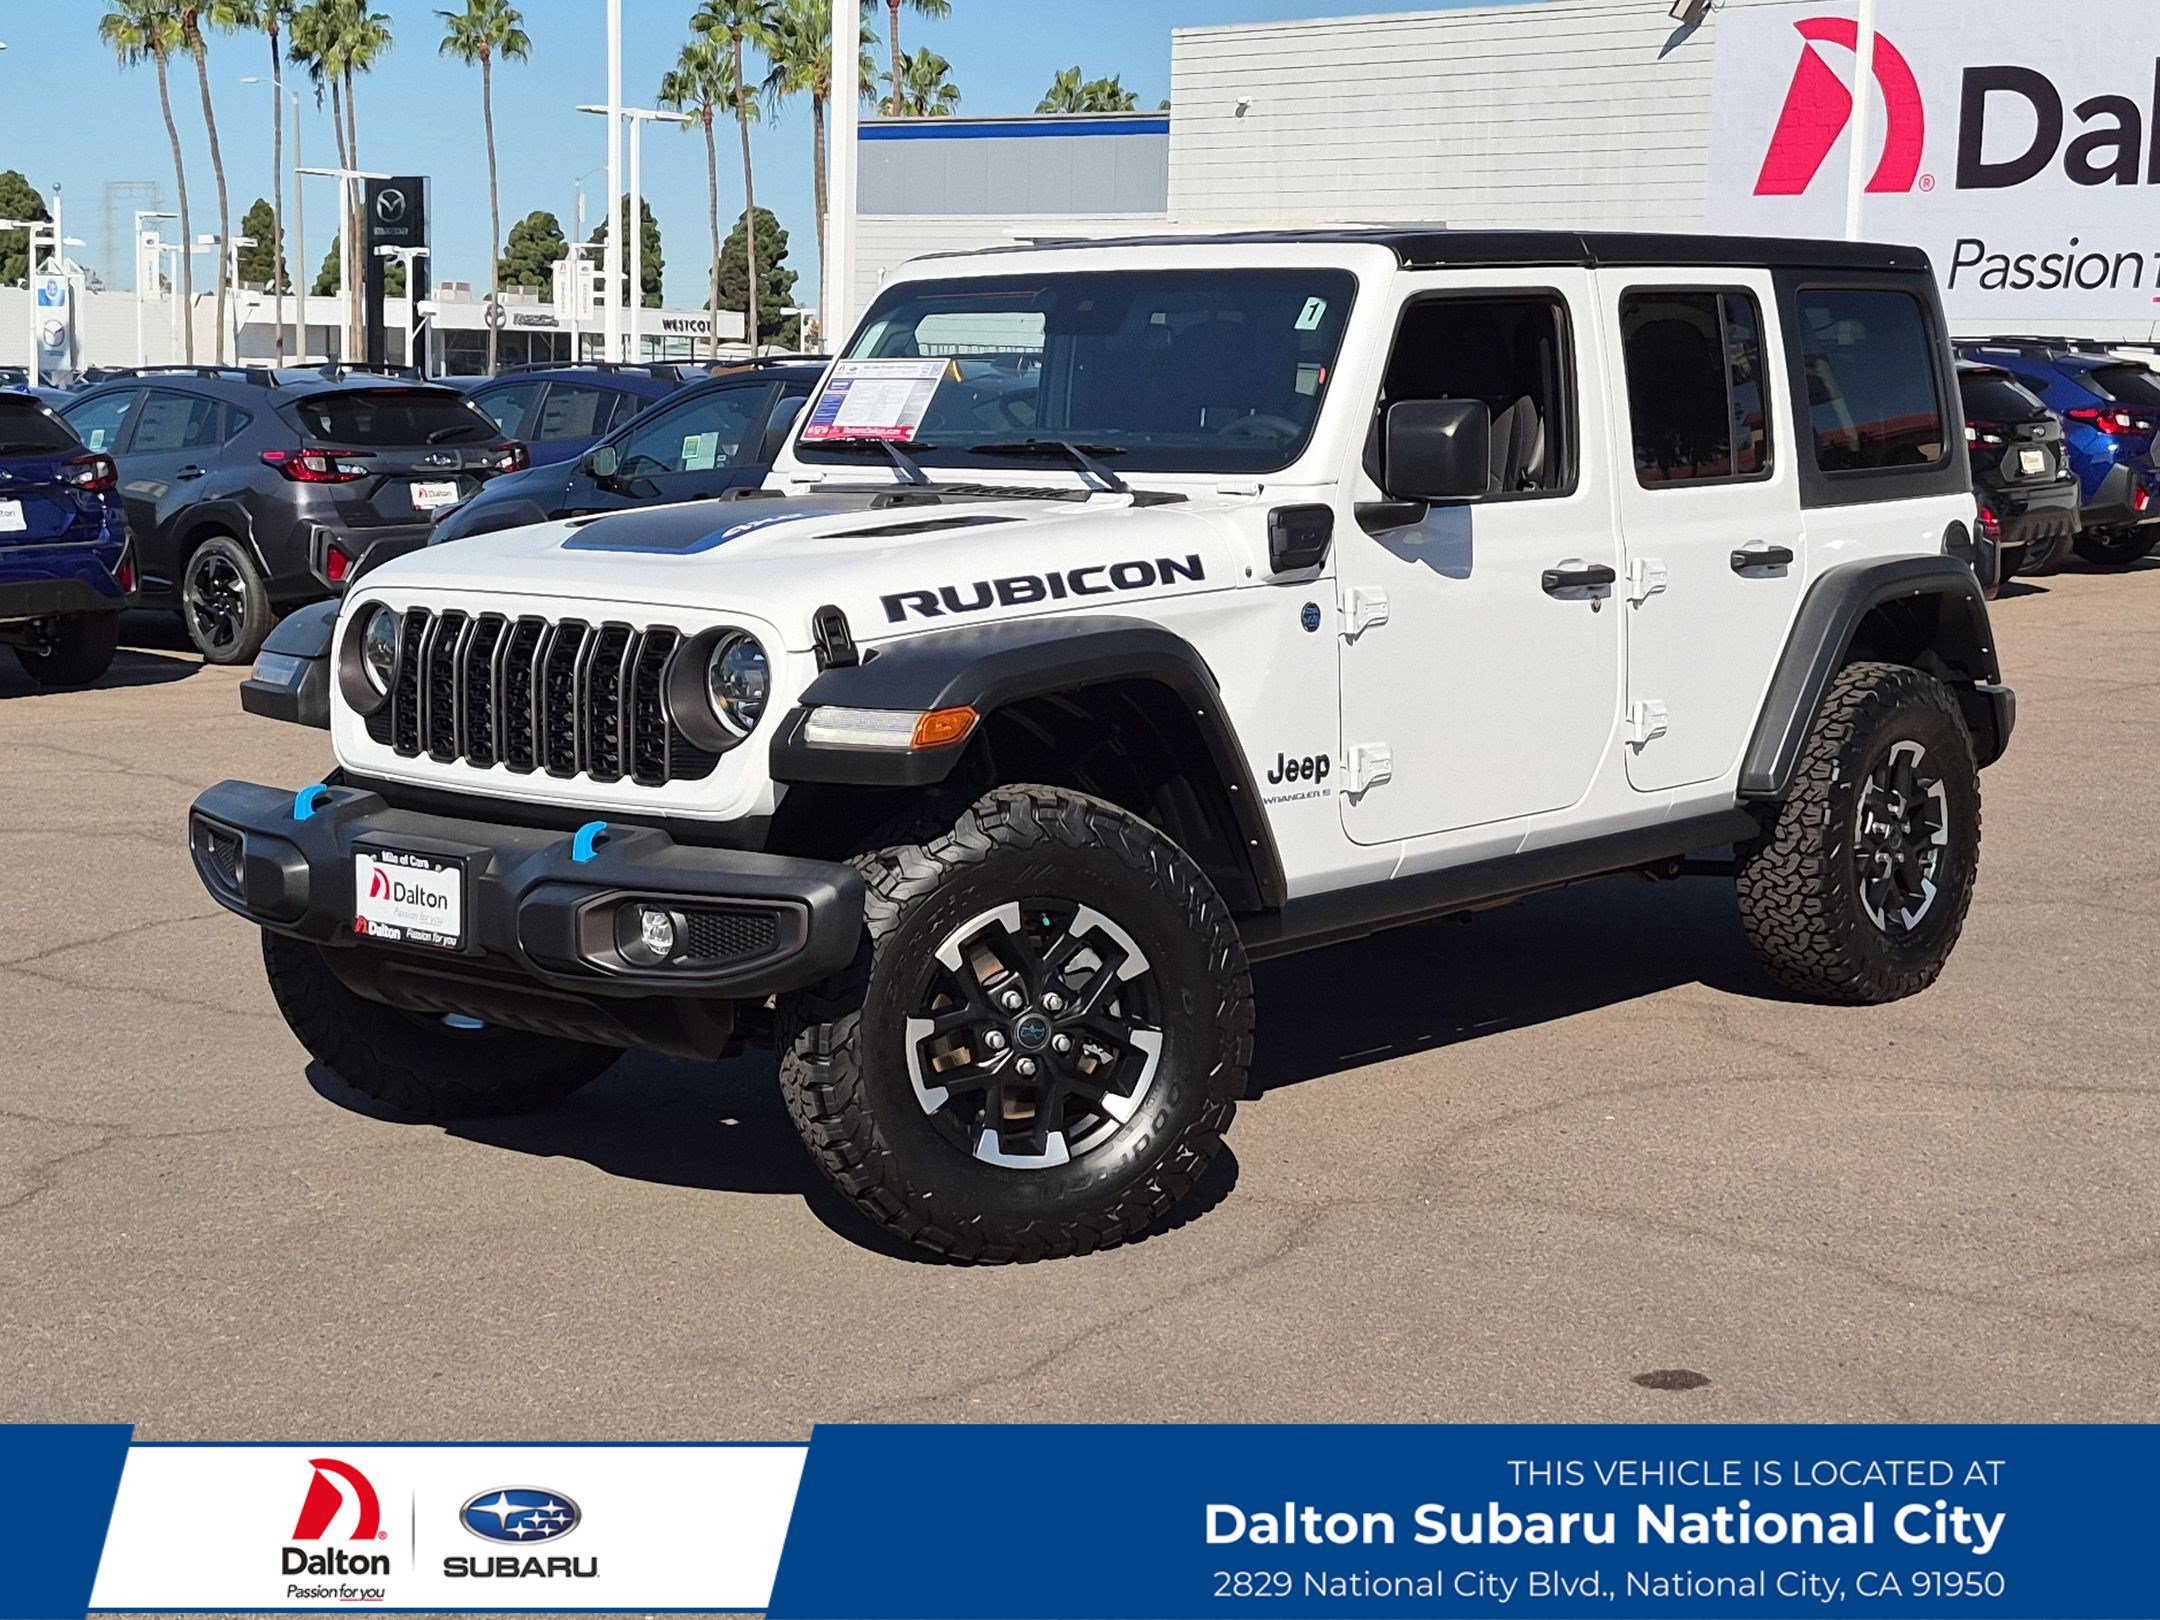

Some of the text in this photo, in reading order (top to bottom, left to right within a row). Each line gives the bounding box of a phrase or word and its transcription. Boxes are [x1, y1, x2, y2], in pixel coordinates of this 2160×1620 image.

[1948, 237, 2144, 290] Passion
[1309, 302, 1320, 322] 1
[879, 554, 1206, 624] RUBICON
[1267, 752, 1331, 785] Jeep
[1263, 790, 1320, 805] WRANGLER
[399, 854, 409, 866] of
[409, 855, 430, 869] Cars
[393, 881, 448, 910] Dalton
[368, 920, 401, 940] Dalton
[406, 927, 458, 947] Passion for you
